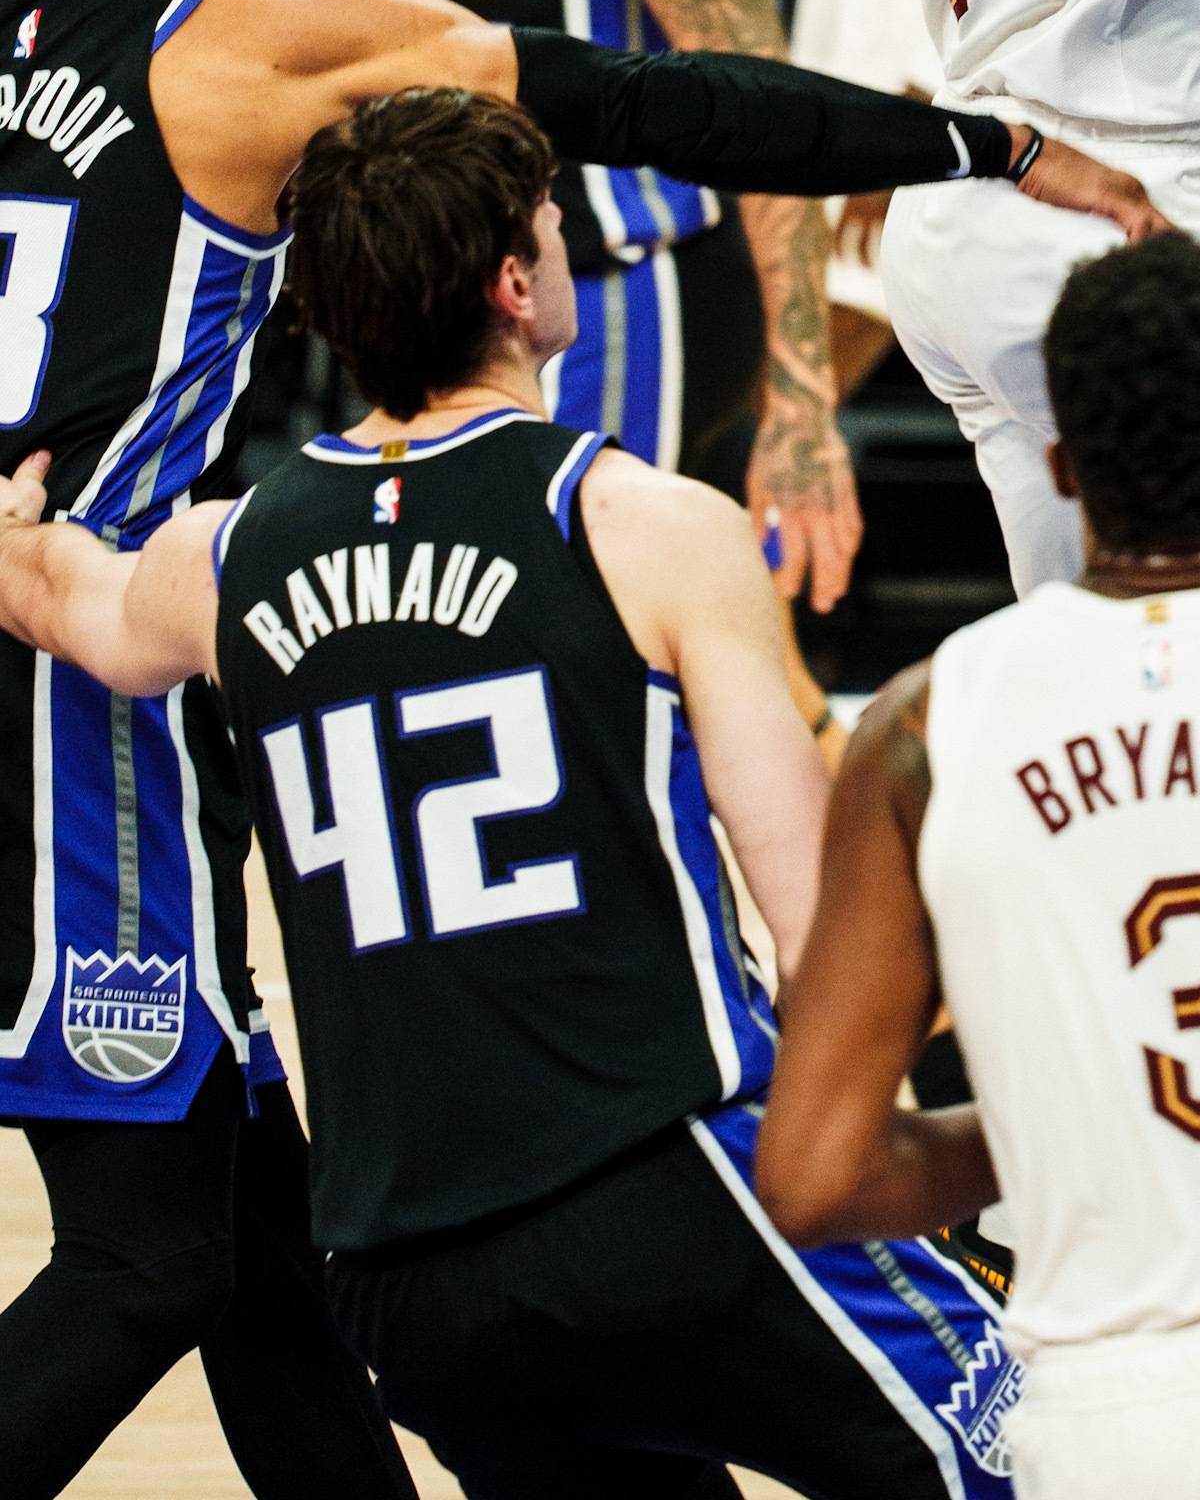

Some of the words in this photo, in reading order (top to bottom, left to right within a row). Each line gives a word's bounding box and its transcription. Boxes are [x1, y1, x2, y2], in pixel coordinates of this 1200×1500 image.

[243, 542, 519, 676] RAYNAUD
[258, 662, 587, 956] 42
[68, 1003, 179, 1033] KINGS
[73, 985, 178, 1005] SACRAMENTO
